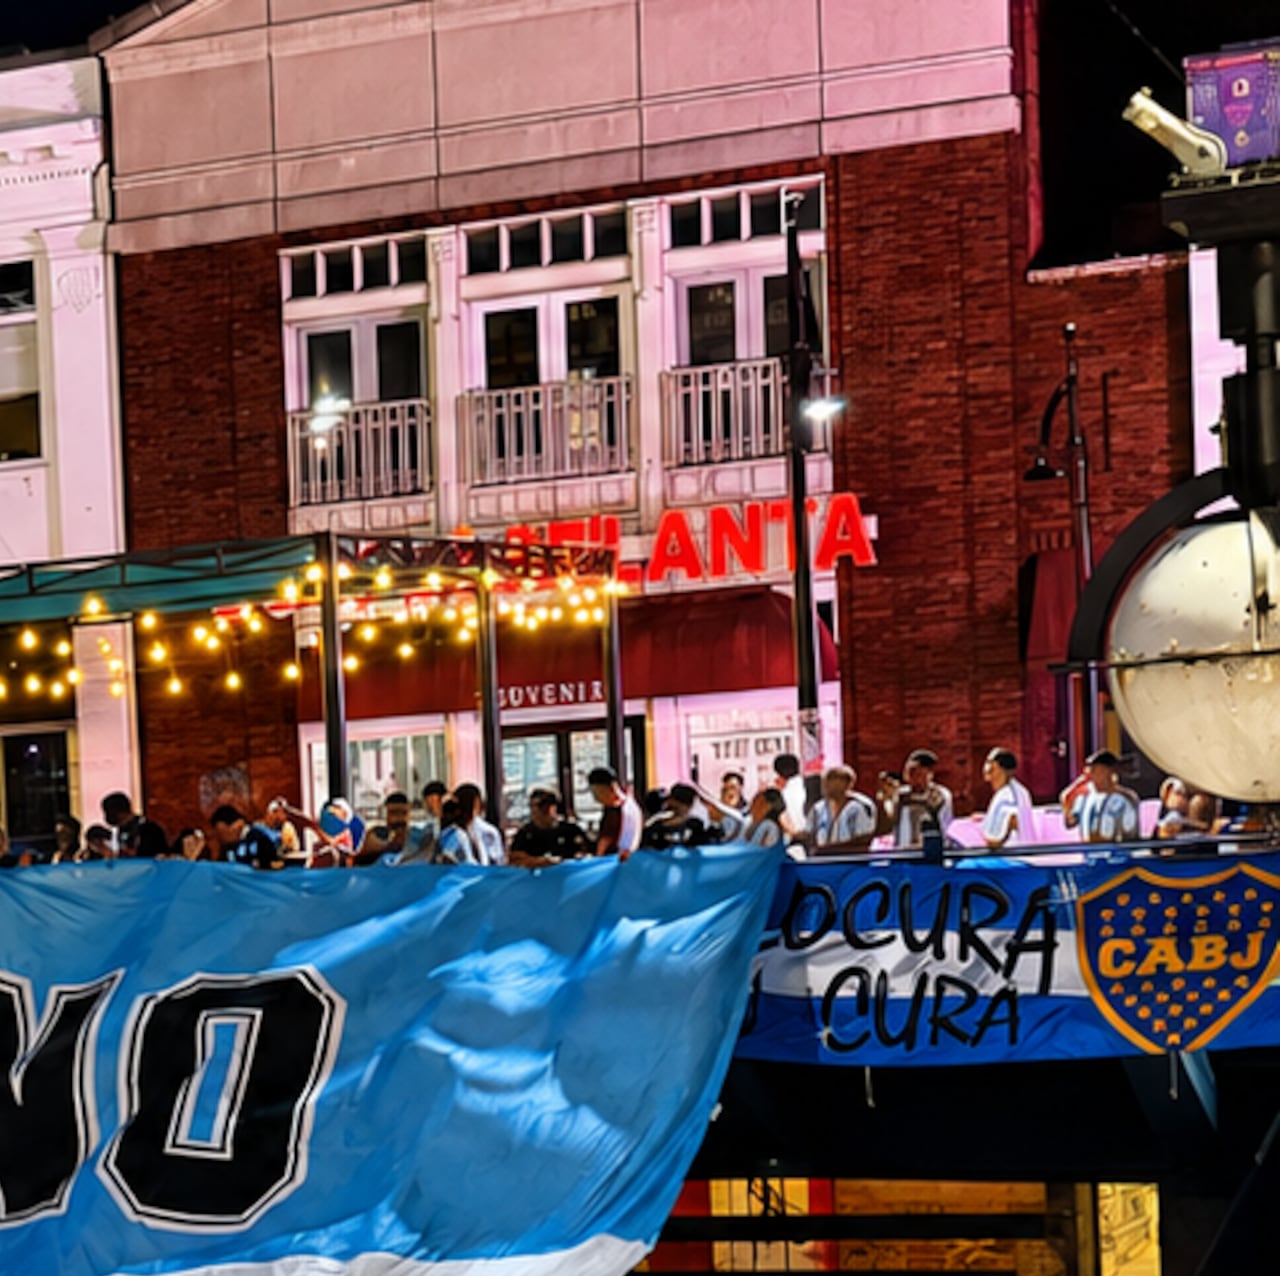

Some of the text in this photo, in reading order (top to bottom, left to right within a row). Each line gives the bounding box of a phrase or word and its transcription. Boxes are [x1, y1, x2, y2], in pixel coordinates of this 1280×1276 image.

[761, 878, 1058, 996] OCURA
[1098, 931, 1266, 979] CABJ
[822, 966, 1021, 1053] CURA
